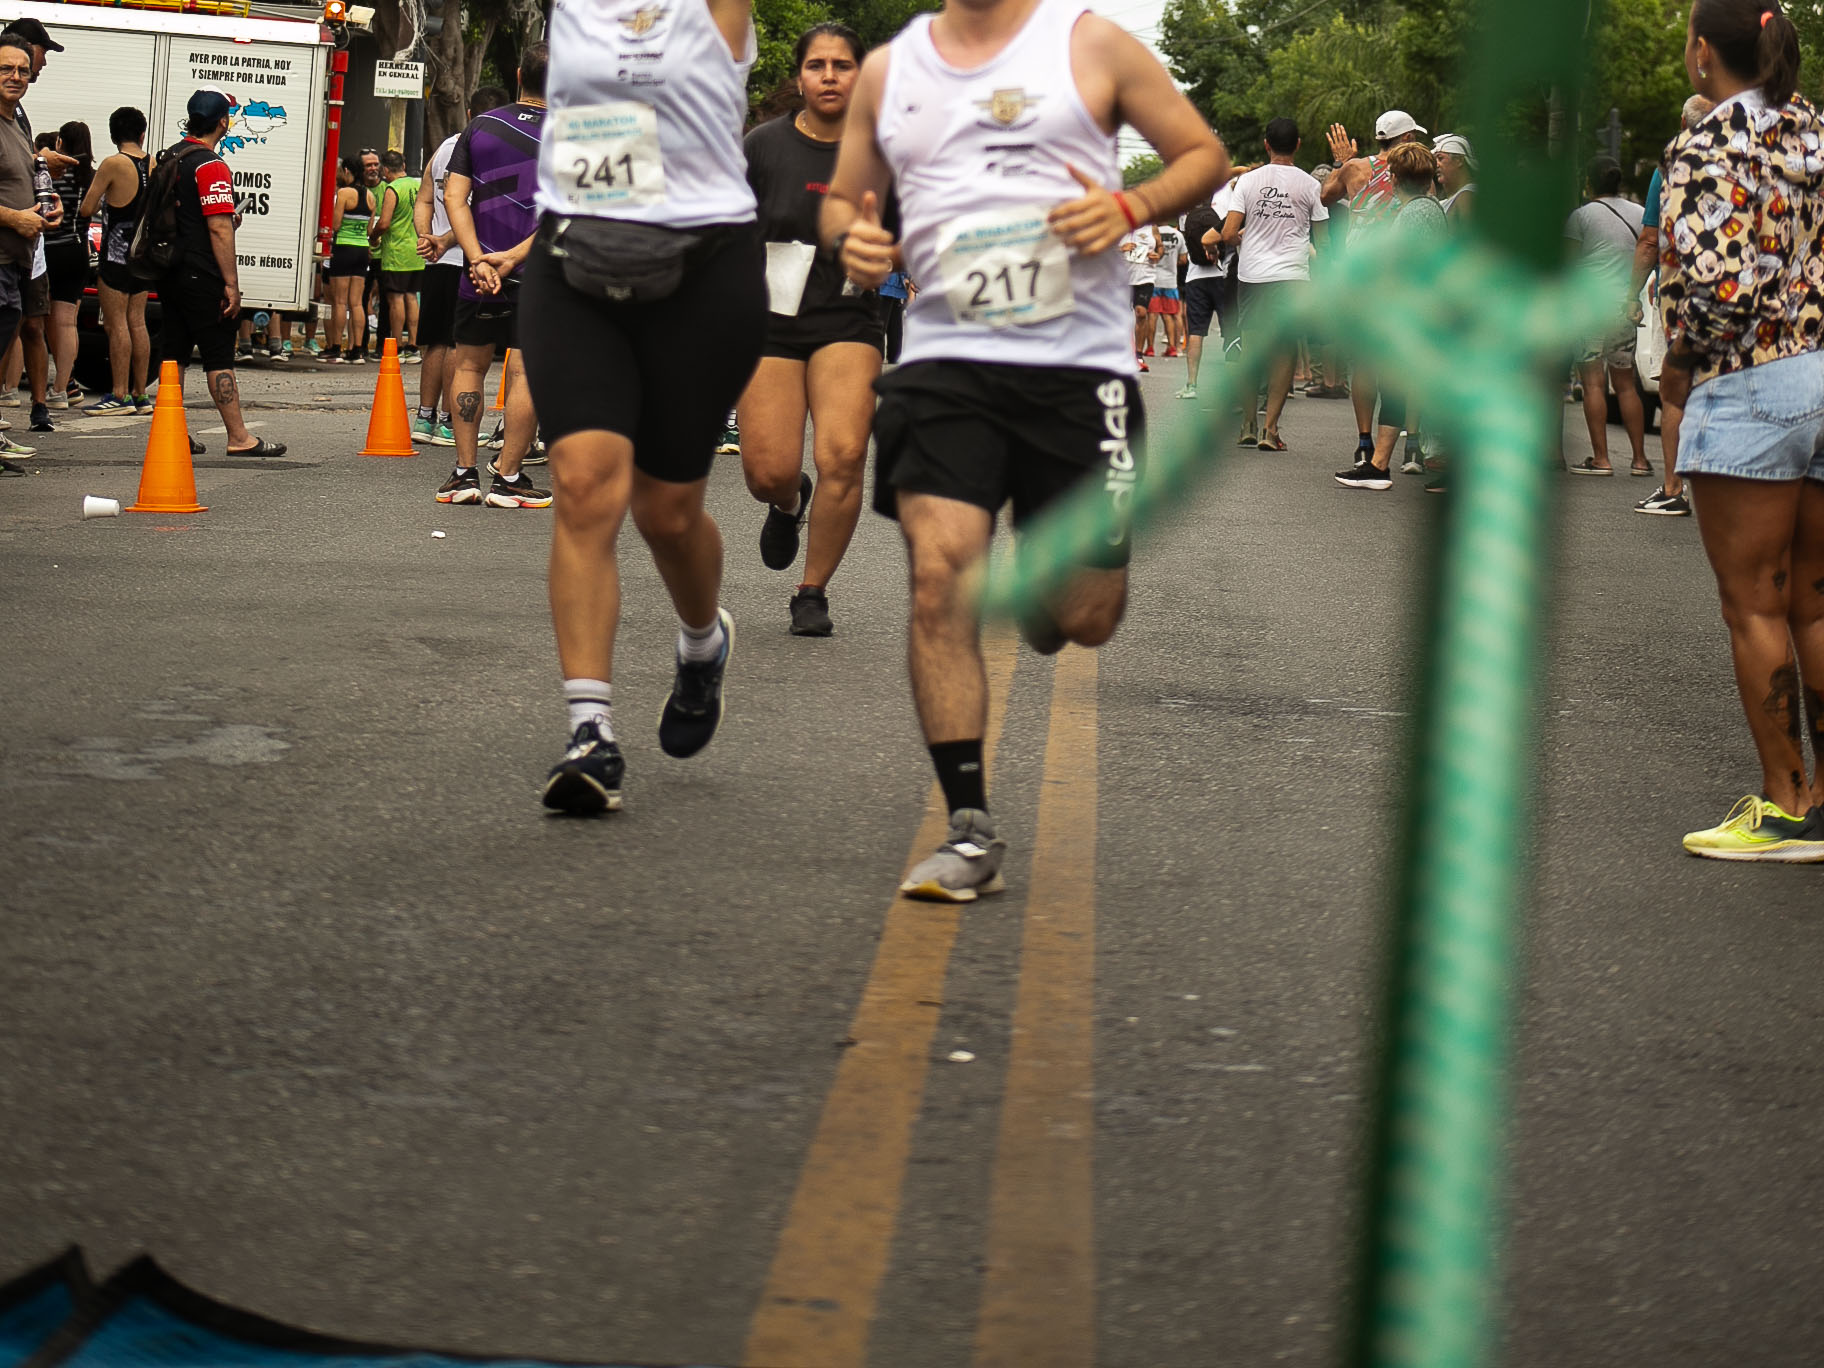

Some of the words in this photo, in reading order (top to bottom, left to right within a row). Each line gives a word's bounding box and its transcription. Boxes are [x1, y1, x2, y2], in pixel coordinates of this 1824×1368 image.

[189, 52, 209, 64] AYER
[211, 54, 228, 65] POR
[229, 56, 239, 66] LA
[241, 57, 272, 69] PATRIA,
[274, 59, 291, 70] HOY
[192, 68, 197, 79] Y
[198, 69, 235, 82] SIEMPRE
[236, 72, 253, 83] POR
[254, 73, 265, 84] LA
[266, 74, 287, 86] VIDA
[389, 72, 419, 80] GENERAL
[573, 153, 634, 188] 241
[231, 171, 272, 190] OMOS
[260, 255, 293, 269] HÉROES
[967, 259, 1041, 307] 217
